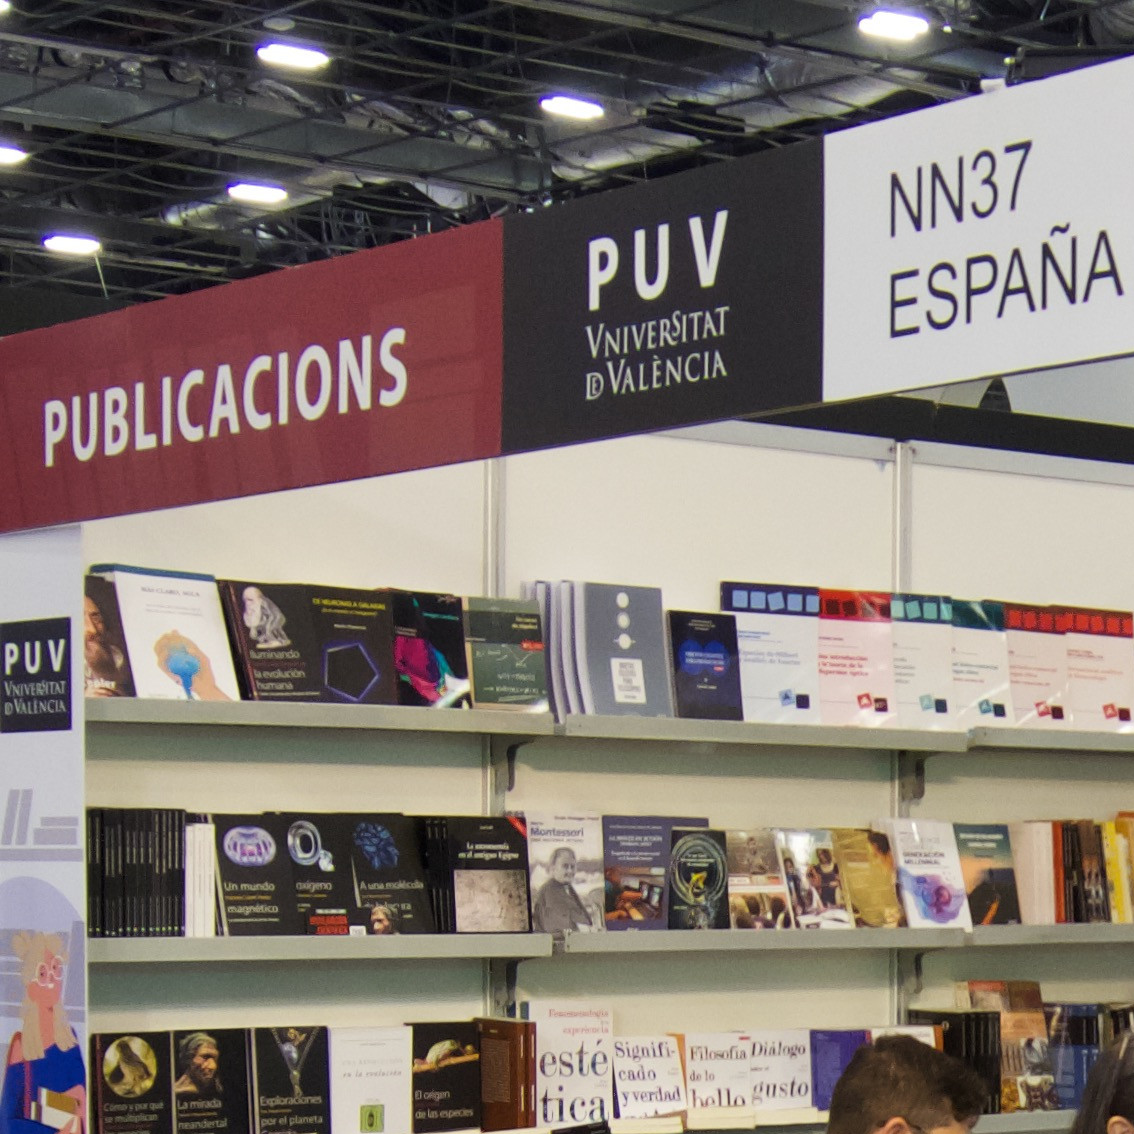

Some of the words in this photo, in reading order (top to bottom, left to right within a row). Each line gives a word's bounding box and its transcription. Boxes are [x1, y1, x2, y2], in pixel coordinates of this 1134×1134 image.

[890, 140, 1033, 238] NN37
[890, 222, 1124, 338] ESPAÑA
[605, 350, 727, 395] VALÈNCIA
[44, 327, 409, 467] PUBLICACIONS
[530, 828, 584, 837] Montessori
[223, 882, 238, 891] Un
[240, 881, 275, 891] mundo
[540, 1039, 609, 1078] esté
[690, 1045, 747, 1061] Filosofía
[751, 1040, 806, 1059] Diálogo
[618, 1065, 657, 1081] cado
[690, 1070, 702, 1081] de
[705, 1070, 715, 1081] lo
[622, 1091, 630, 1107] y
[632, 1085, 682, 1102] verdad
[751, 1076, 809, 1104] gusto
[177, 1100, 188, 1110] La
[190, 1098, 222, 1108] mirada
[541, 1085, 610, 1123] tica
[178, 1118, 228, 1130] neandertal
[261, 1119, 277, 1128] por
[279, 1116, 287, 1125] el
[289, 1115, 323, 1127] planeta
